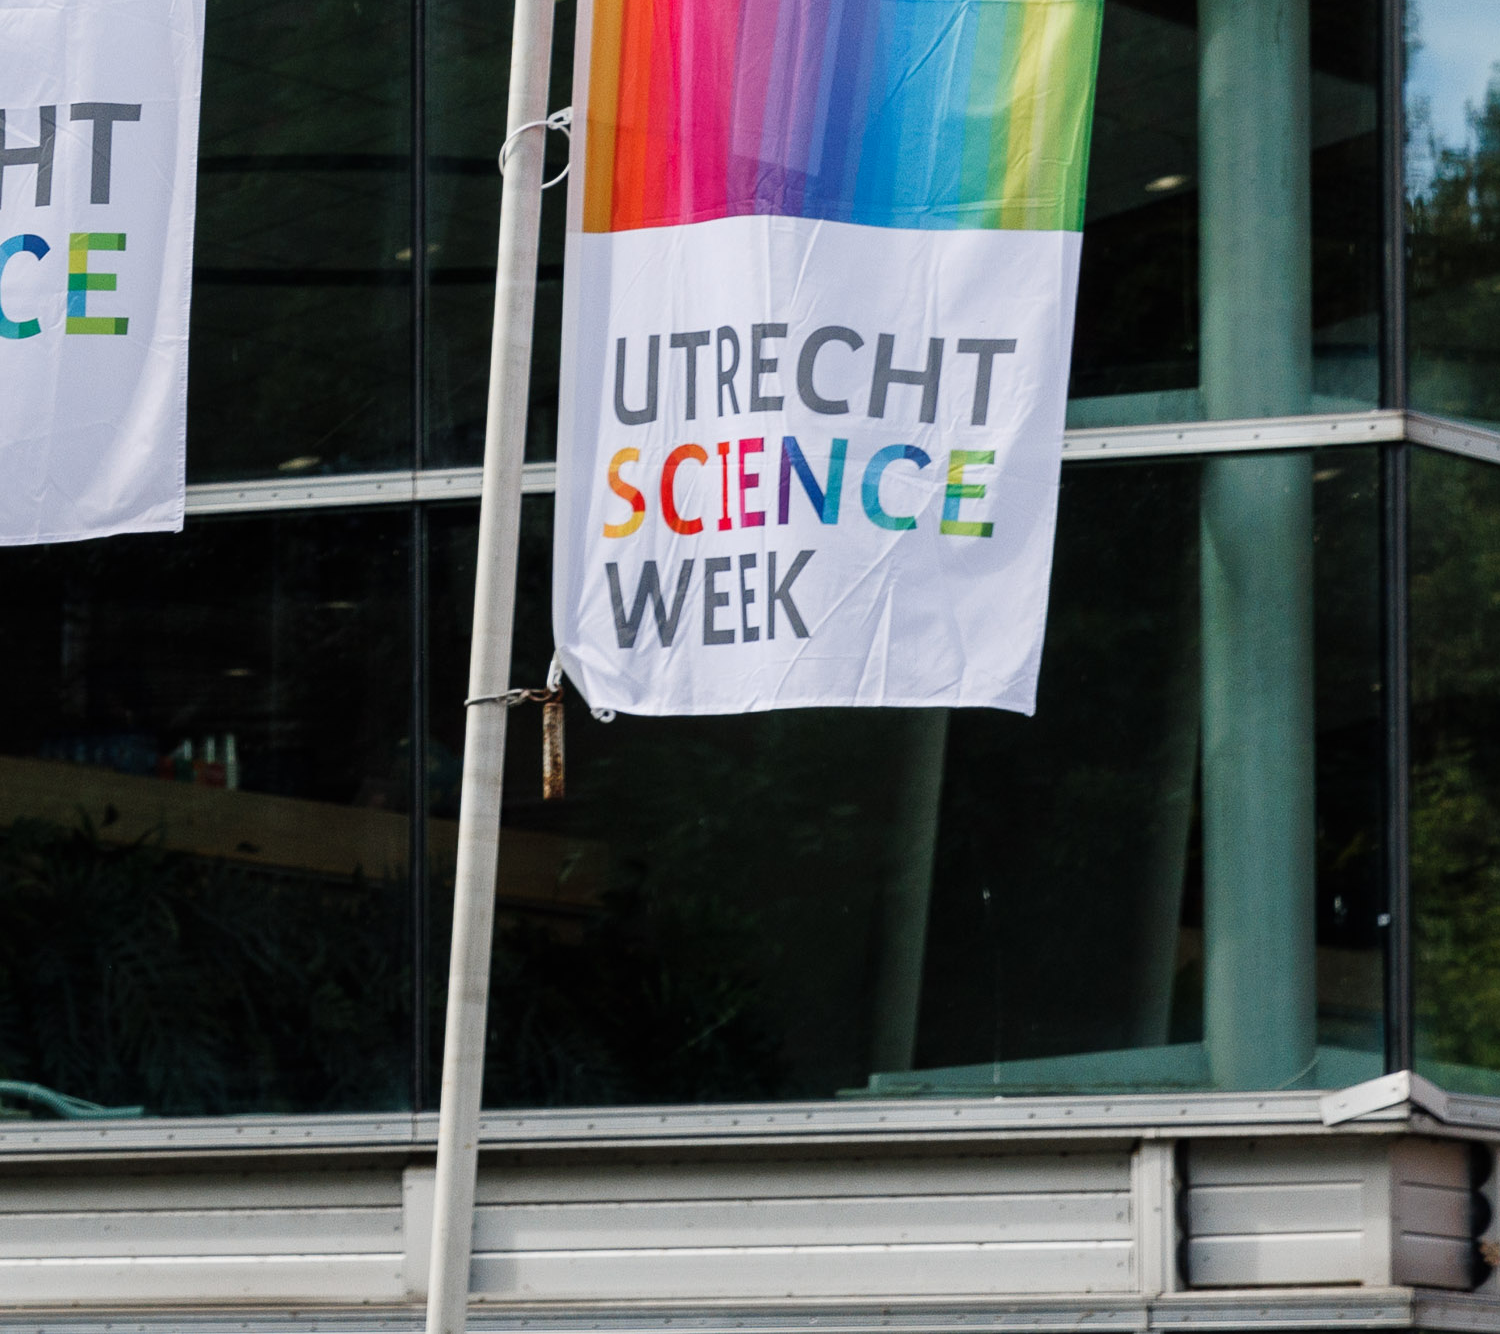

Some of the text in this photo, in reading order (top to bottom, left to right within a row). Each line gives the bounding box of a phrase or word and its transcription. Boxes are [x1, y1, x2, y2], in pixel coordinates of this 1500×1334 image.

[614, 322, 1016, 426] UTRECHT
[603, 436, 996, 539] SCIENCE
[605, 549, 816, 649] WEEK
